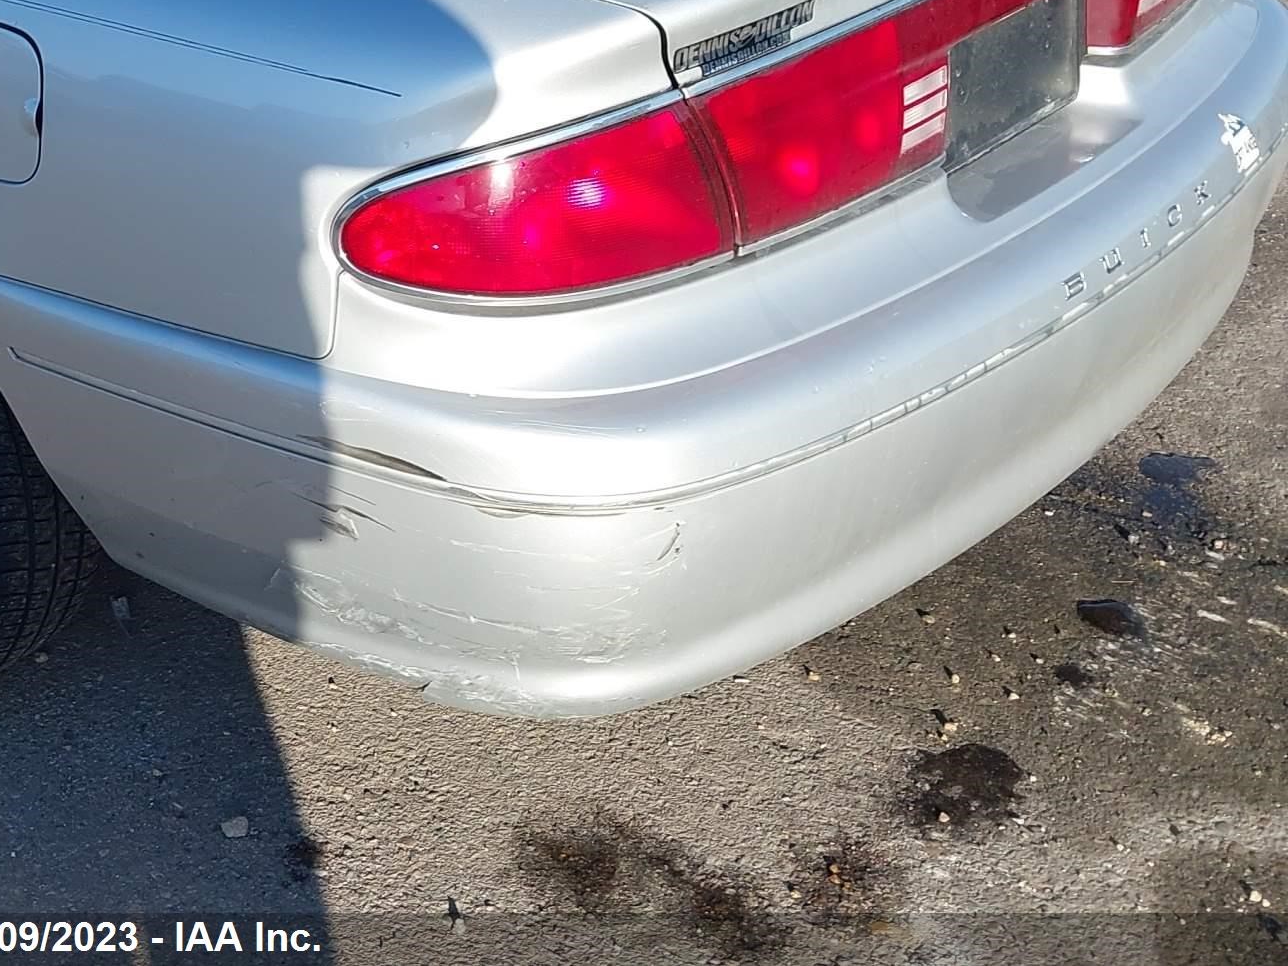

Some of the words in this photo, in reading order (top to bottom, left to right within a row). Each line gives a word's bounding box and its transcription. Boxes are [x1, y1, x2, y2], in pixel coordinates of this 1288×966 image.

[674, 29, 741, 73] DENNIS
[753, 0, 815, 43] DILLON
[702, 32, 791, 76] DENNISDILLON.COM
[1062, 180, 1212, 301] BUICK
